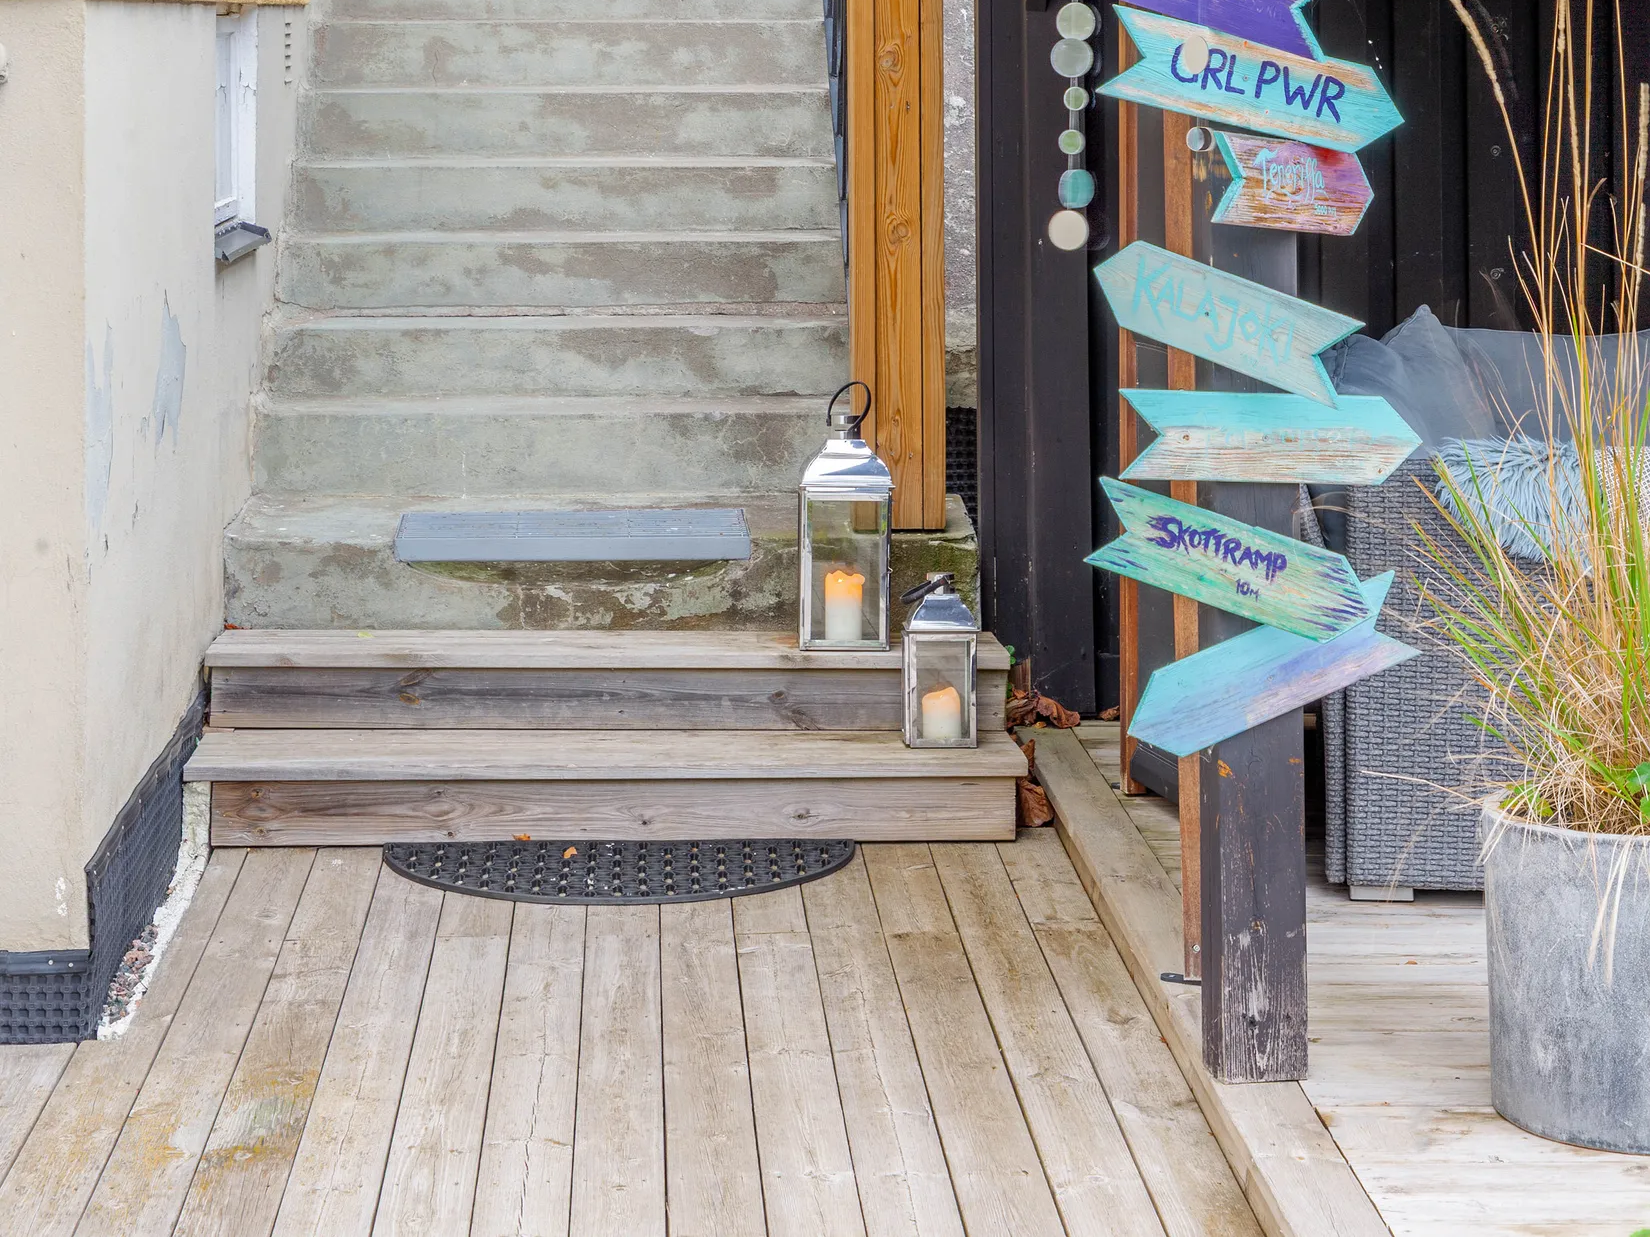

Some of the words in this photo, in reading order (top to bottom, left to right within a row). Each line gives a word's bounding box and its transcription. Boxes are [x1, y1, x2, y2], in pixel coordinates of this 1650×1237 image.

[1254, 60, 1346, 124] PWR
[1252, 147, 1326, 204] Teneriffa
[1131, 253, 1296, 367] KALAJOKI
[1145, 514, 1288, 583] SKOTTRAMP
